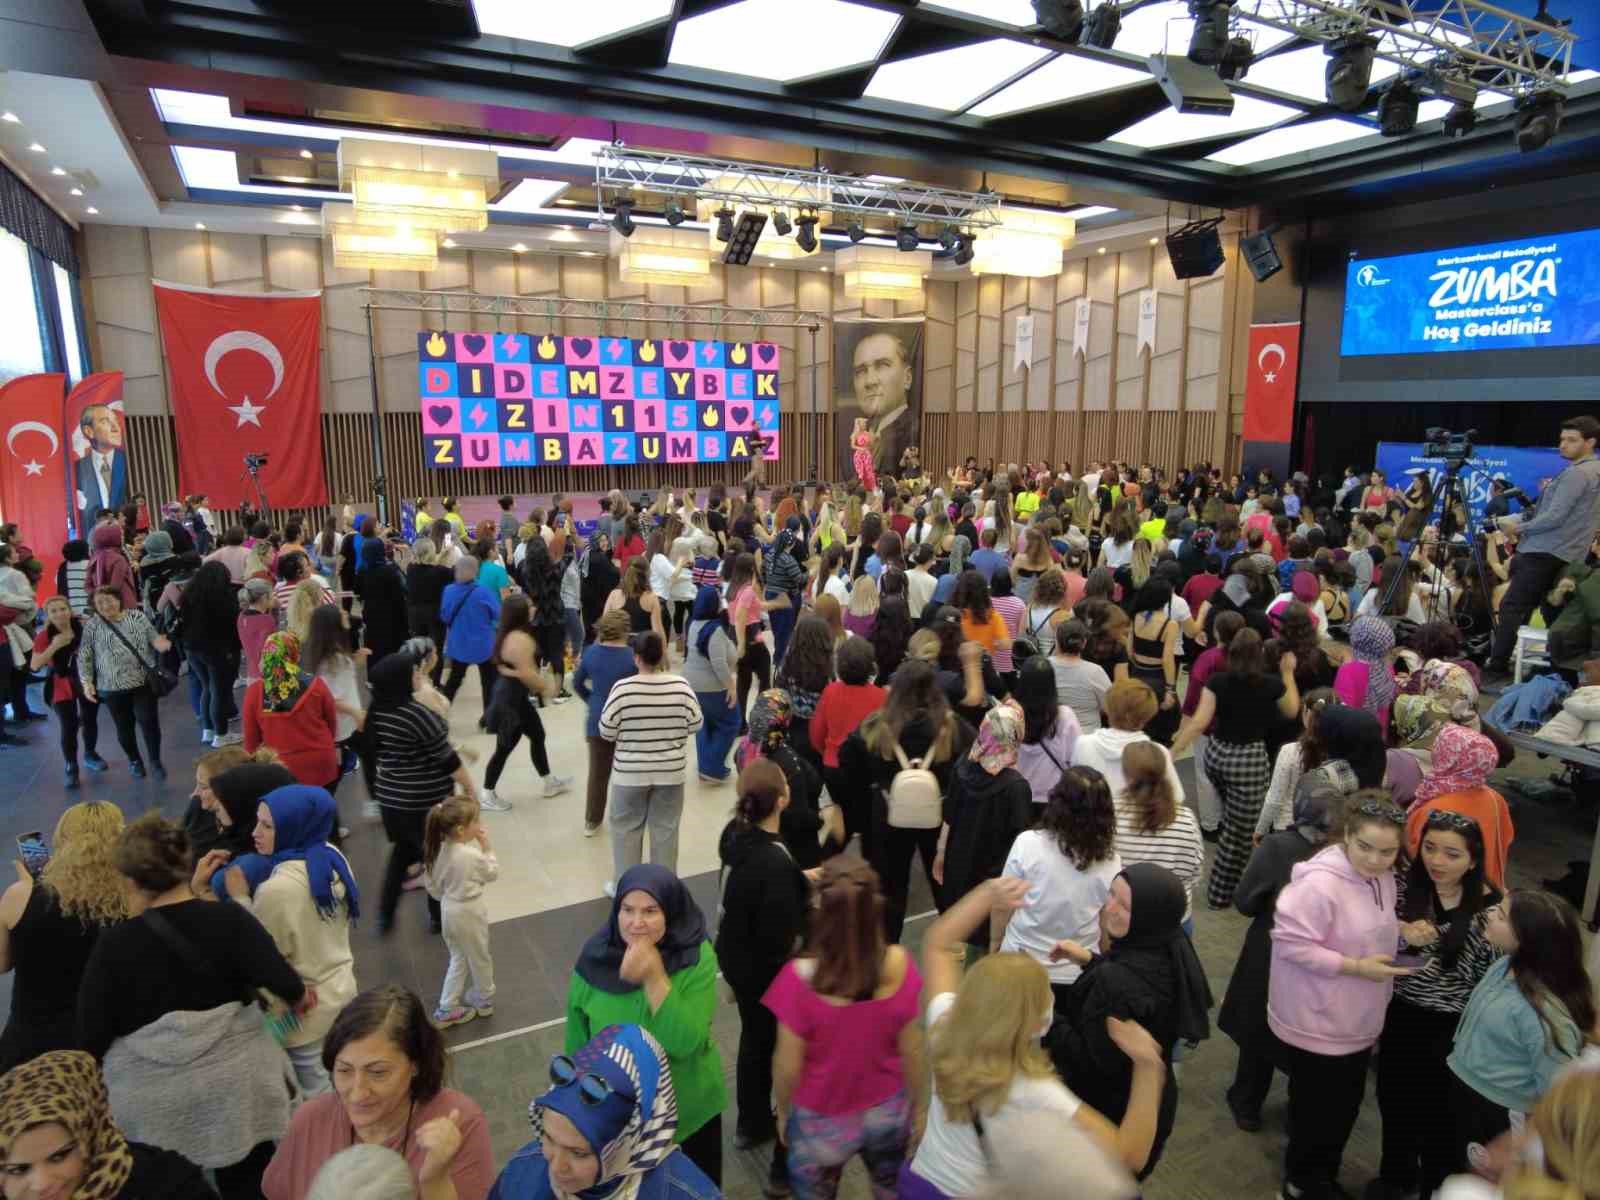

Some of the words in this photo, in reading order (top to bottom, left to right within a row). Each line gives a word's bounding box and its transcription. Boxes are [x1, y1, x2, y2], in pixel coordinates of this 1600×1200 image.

[1428, 257, 1558, 307] ZUMBA
[1423, 325, 1460, 343] Hoş
[1463, 316, 1552, 337] Geldiniz
